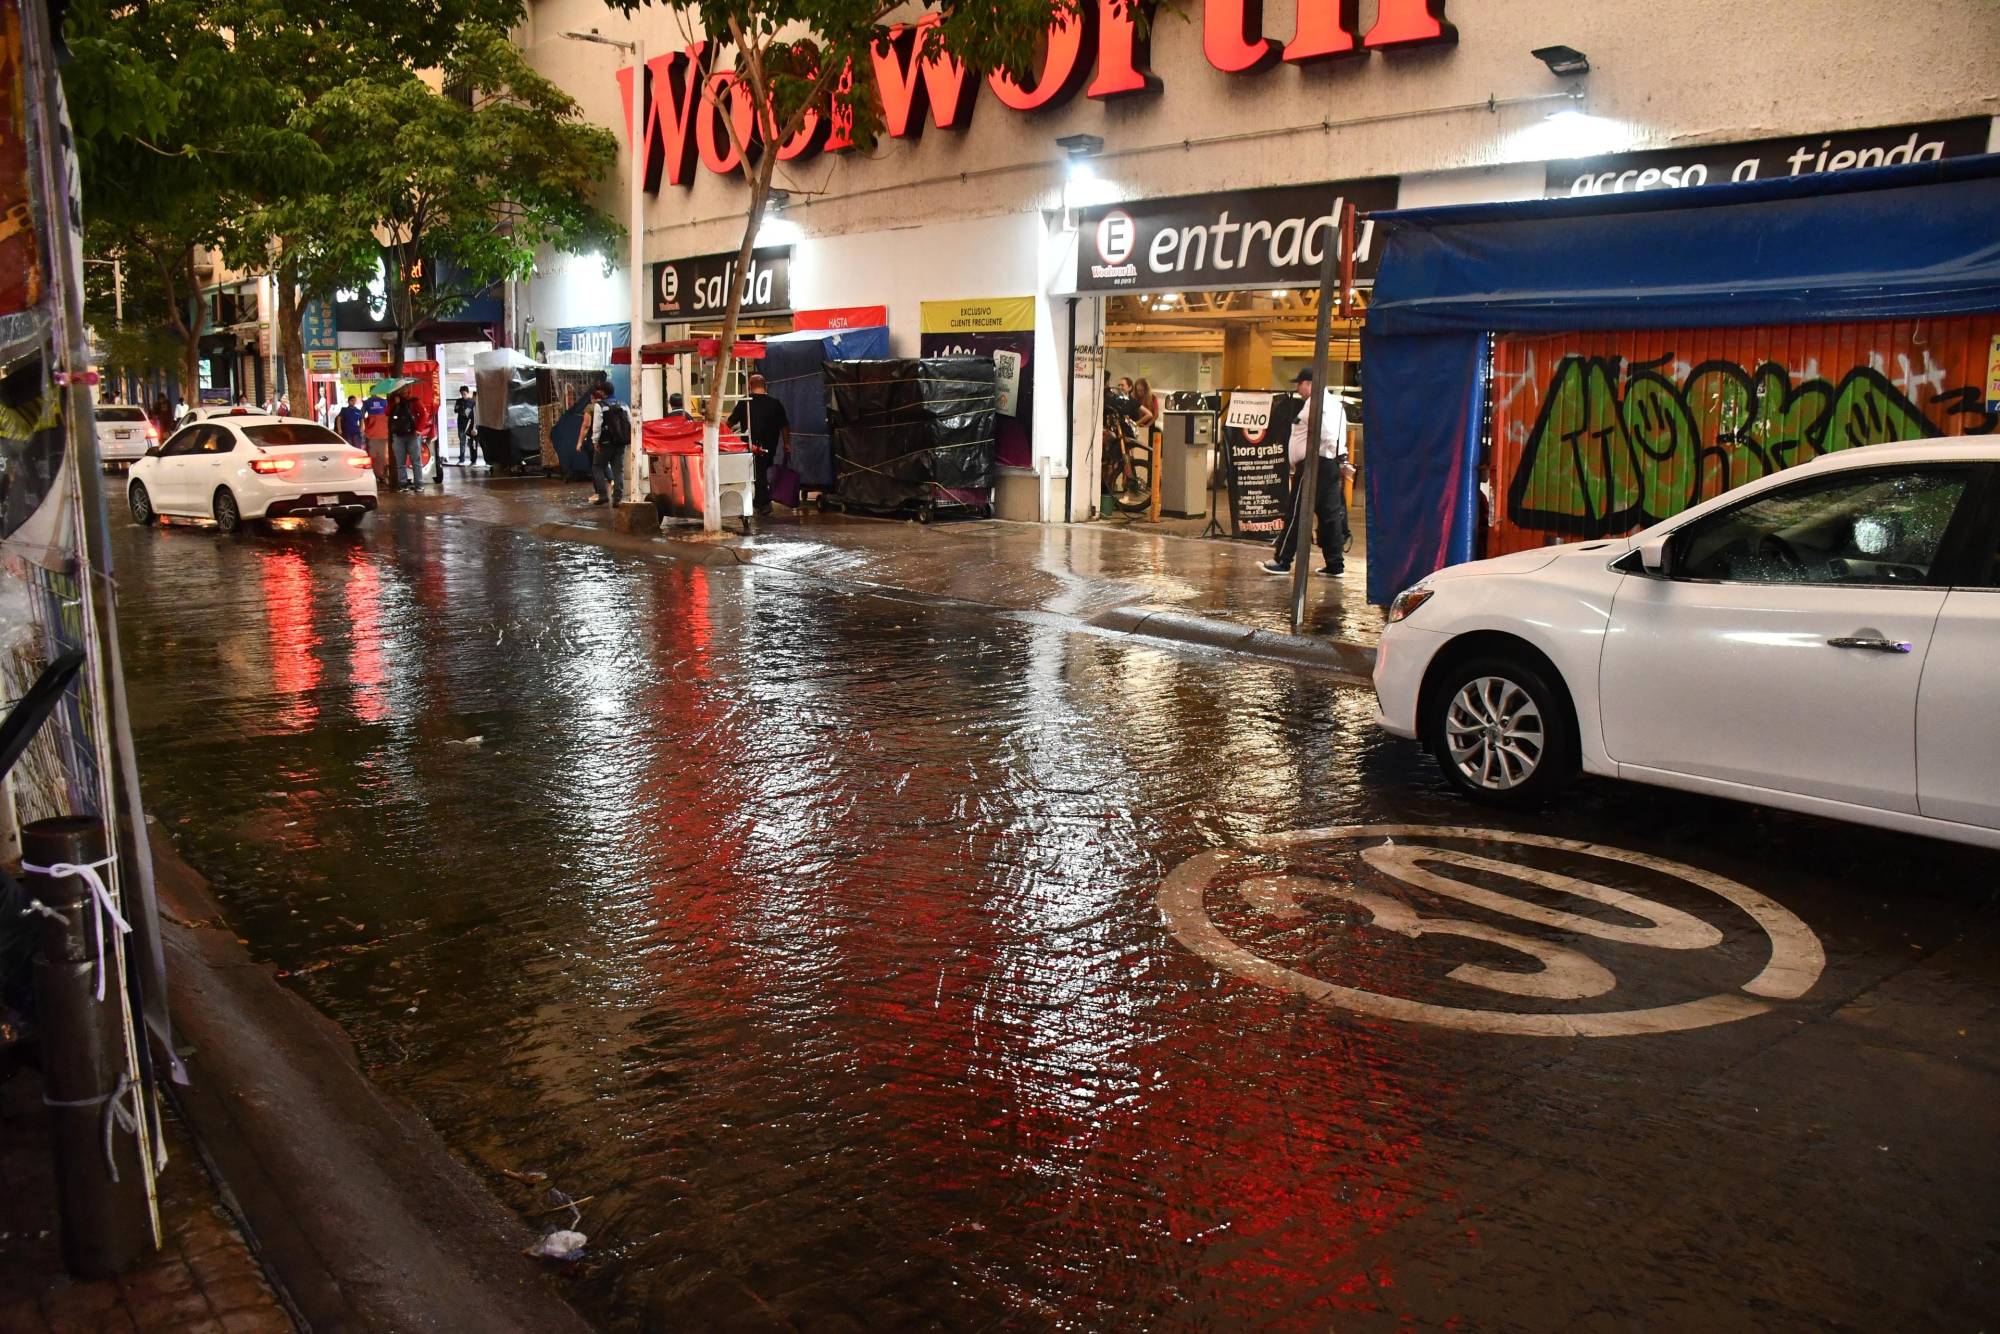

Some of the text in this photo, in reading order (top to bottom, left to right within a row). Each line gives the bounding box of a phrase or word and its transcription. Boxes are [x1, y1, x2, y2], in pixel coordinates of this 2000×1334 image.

[1570, 162, 1709, 197] acceso
[1148, 196, 1374, 274] entrada
[960, 307, 992, 316] EXCLUSIVO
[828, 318, 848, 328] HASTA
[950, 317, 1003, 328] CLIENTE FRECUENTE
[1229, 412, 1267, 426] LLENO
[1238, 843, 1724, 1000] 30
